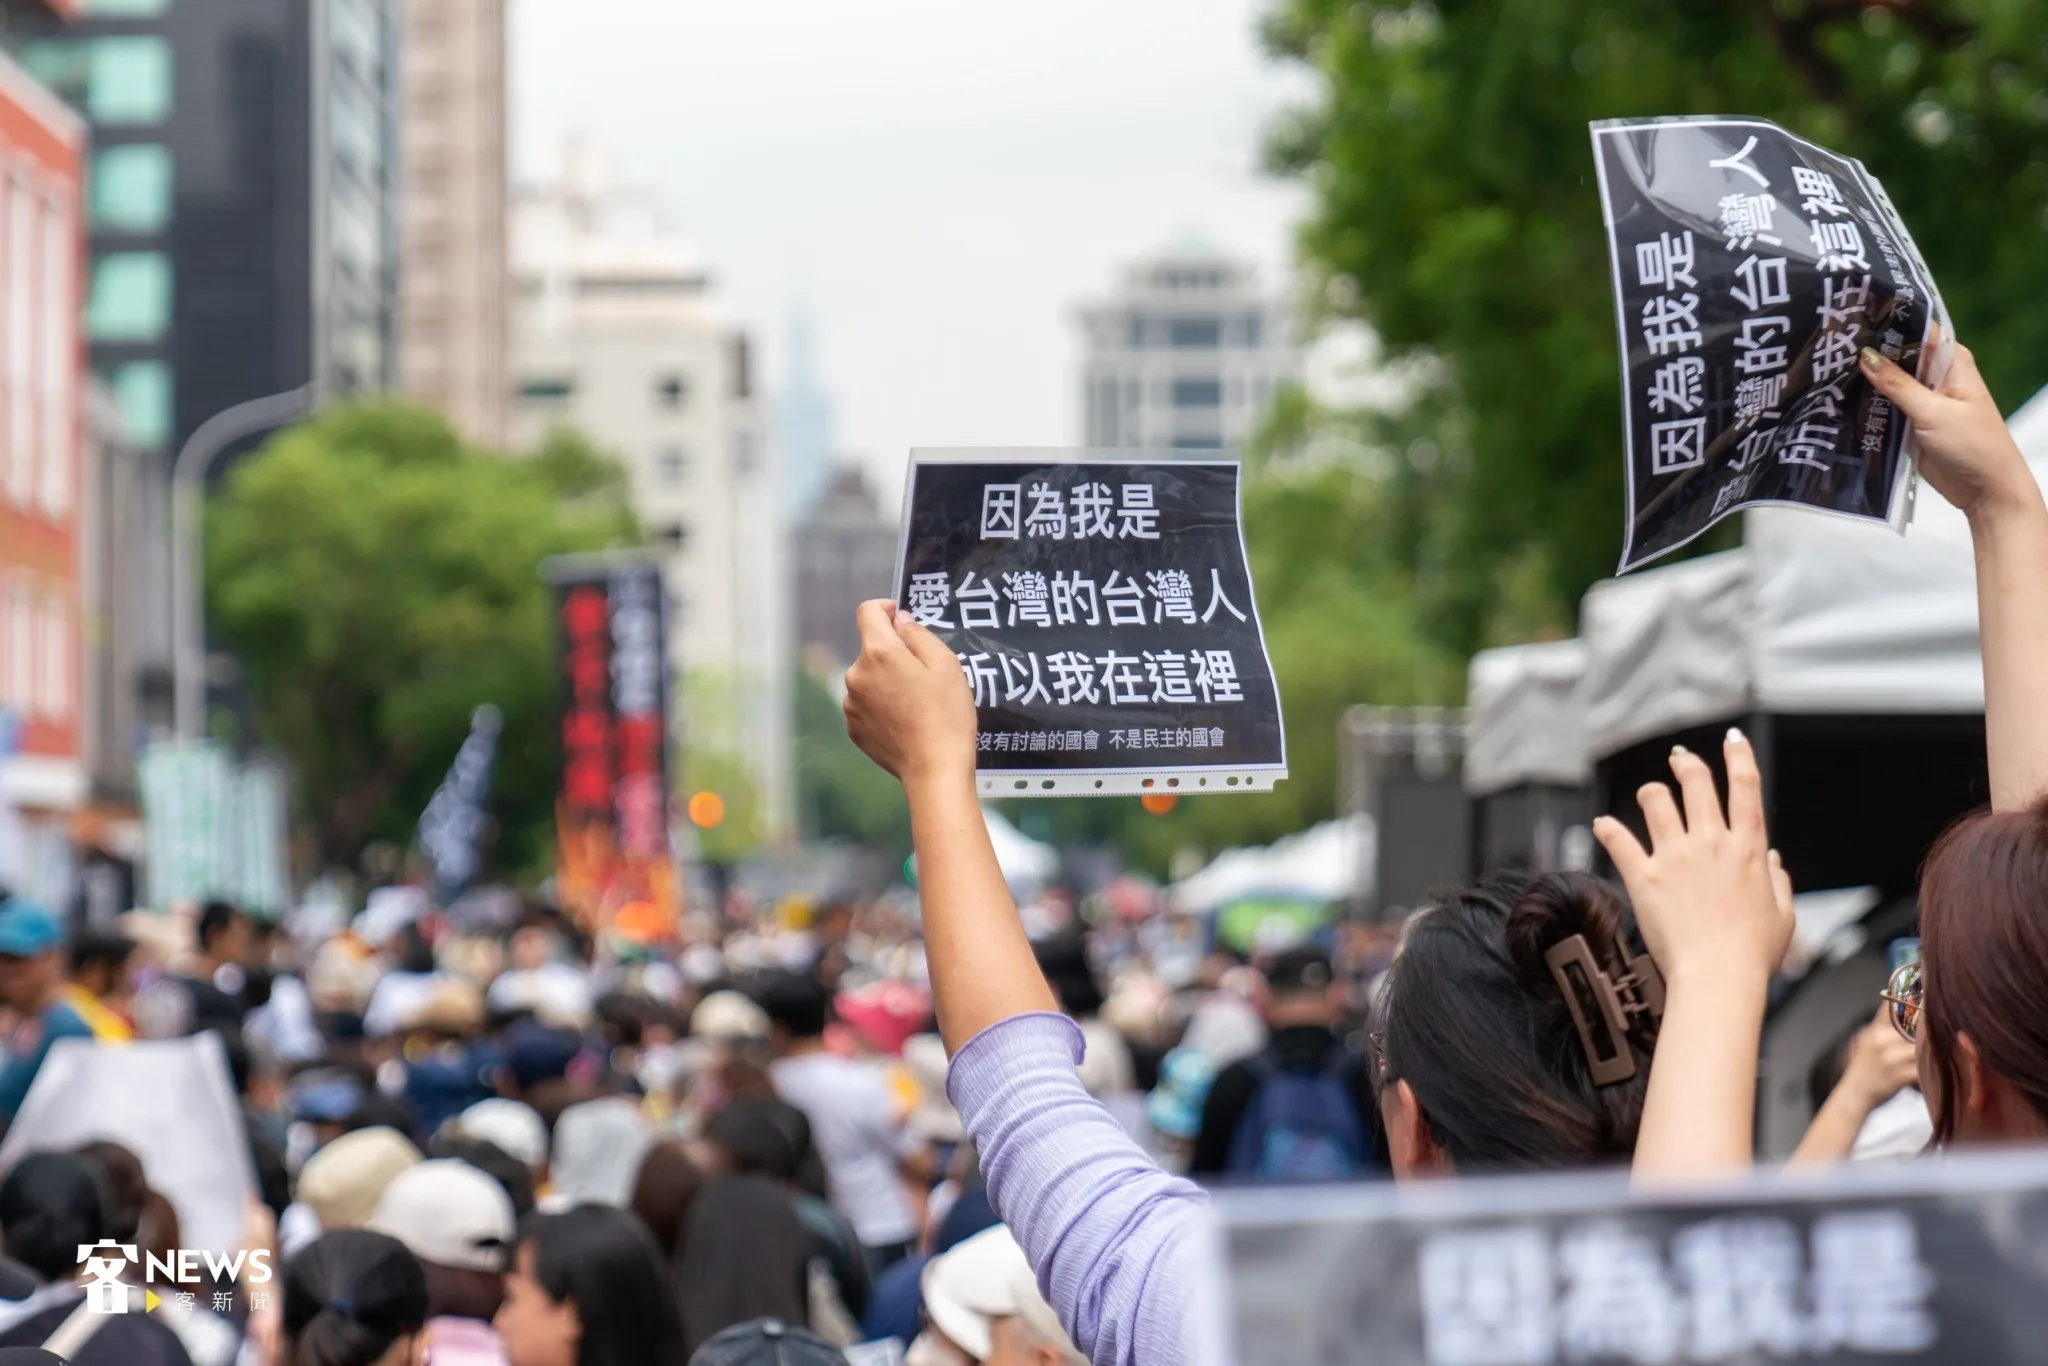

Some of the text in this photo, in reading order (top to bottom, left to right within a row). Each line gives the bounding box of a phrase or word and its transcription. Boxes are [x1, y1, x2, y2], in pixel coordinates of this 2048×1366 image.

[1636, 230, 1706, 476] 因為我是
[1778, 165, 1872, 472] 所以我在這裡
[1860, 327, 1905, 453] 沒有討國會
[979, 482, 1161, 541] 因為我是
[907, 567, 1248, 629] 愛台灣的台灣人
[975, 726, 1226, 752] 沒有討論的國會 不是民主的國會
